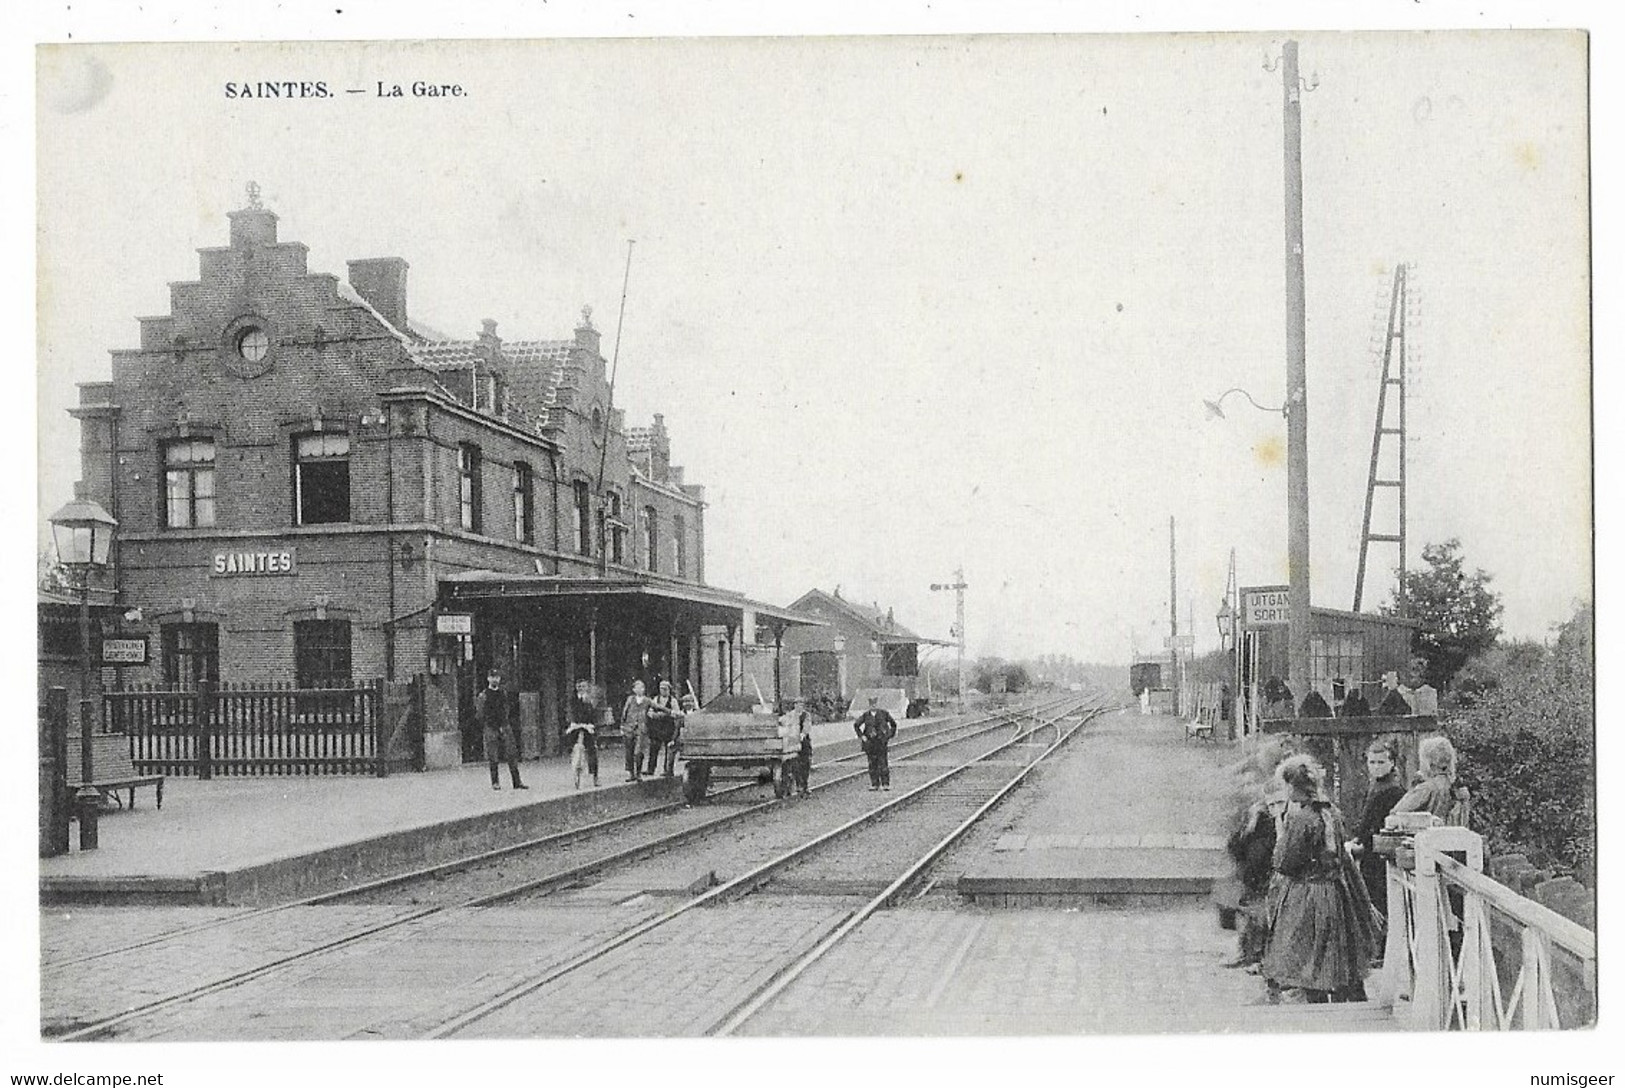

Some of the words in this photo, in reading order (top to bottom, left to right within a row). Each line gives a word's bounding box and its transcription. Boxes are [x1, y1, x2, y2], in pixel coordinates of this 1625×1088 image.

[214, 553, 291, 573] SAINTES
[1251, 594, 1290, 606] UITGAN
[1254, 609, 1290, 620] SORTI
